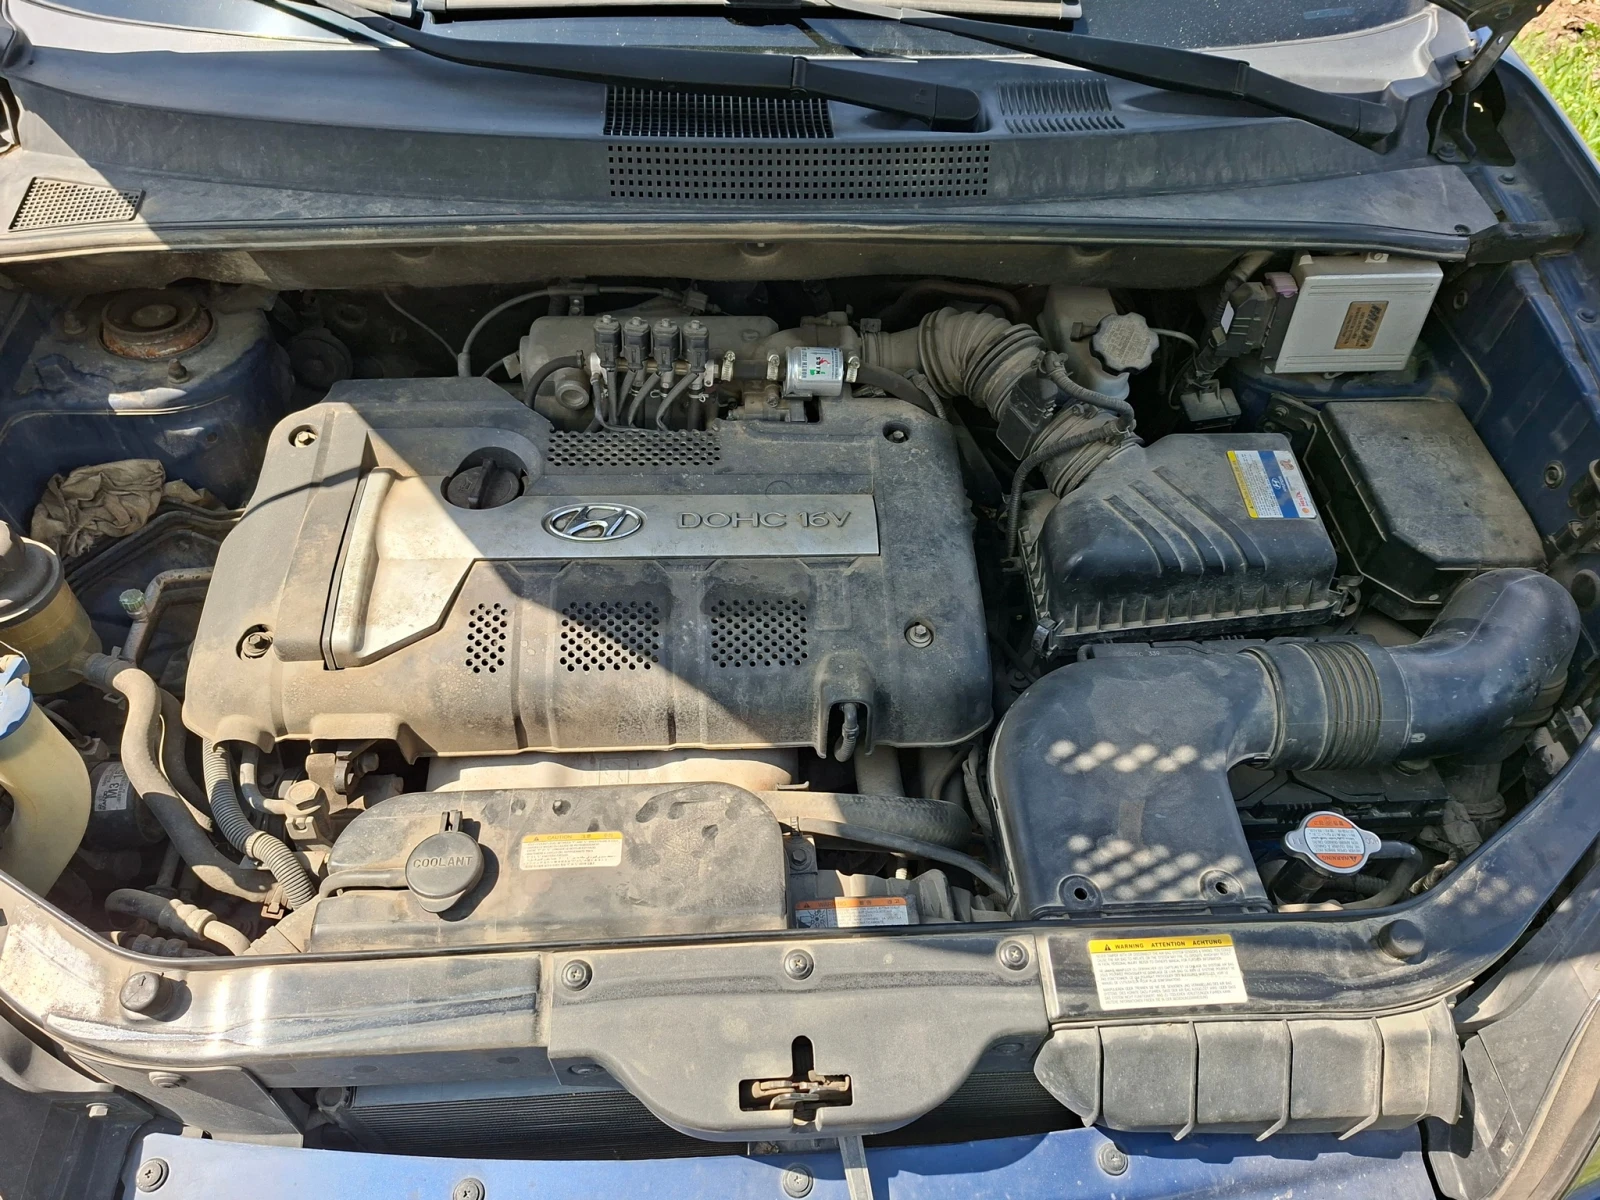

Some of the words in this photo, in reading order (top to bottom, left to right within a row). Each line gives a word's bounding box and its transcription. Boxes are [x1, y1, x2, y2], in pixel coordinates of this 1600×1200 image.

[678, 511, 787, 529] DOHC
[798, 511, 851, 528] 16V
[413, 855, 473, 869] COOLANT
